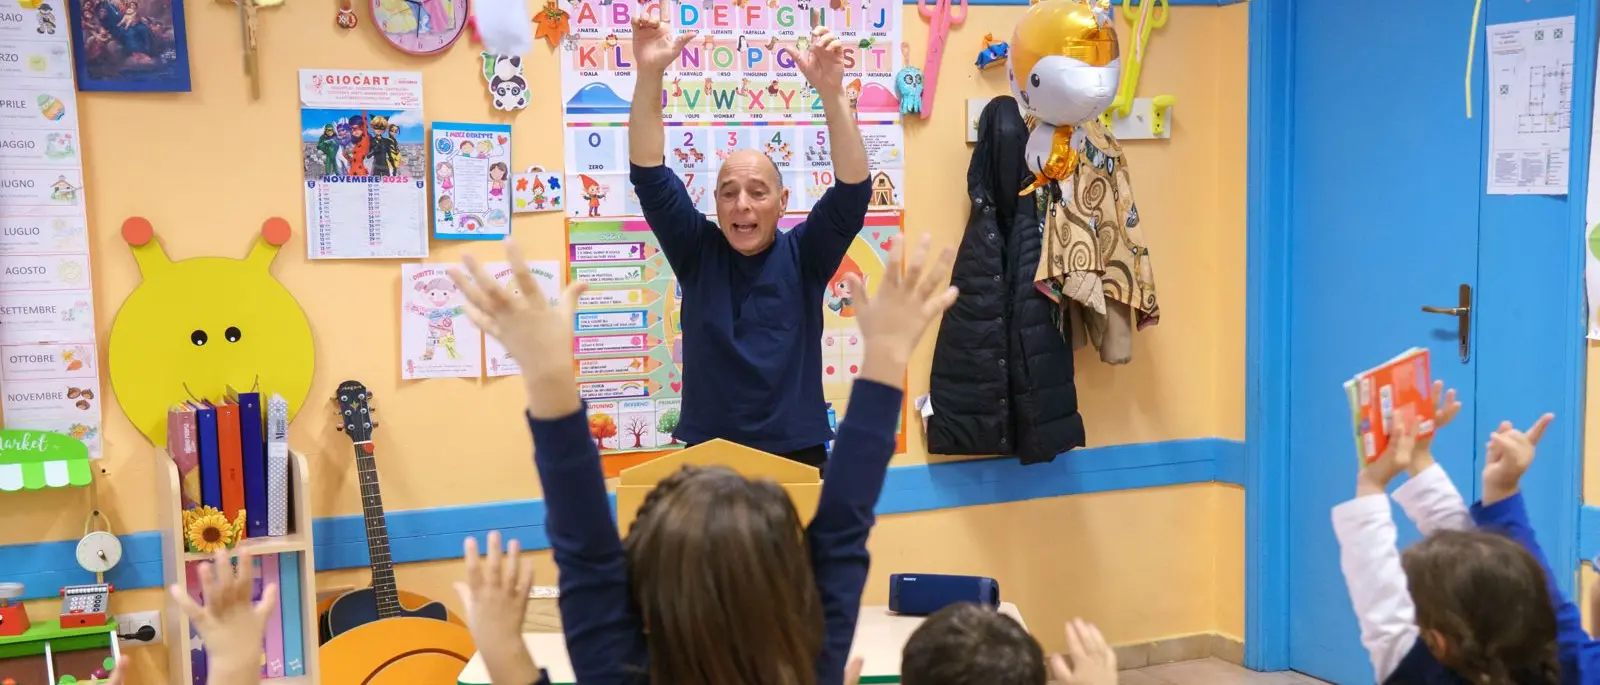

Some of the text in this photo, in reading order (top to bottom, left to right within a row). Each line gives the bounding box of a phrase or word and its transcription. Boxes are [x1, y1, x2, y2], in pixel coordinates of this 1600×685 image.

[577, 2, 597, 24] A
[613, 3, 630, 24] B
[681, 5, 698, 26] D
[714, 6, 728, 26] E
[746, 6, 761, 26] F
[776, 6, 794, 27] G
[846, 8, 850, 28] I
[874, 8, 886, 28] J
[580, 46, 885, 68] K L N O P Q S T
[326, 75, 390, 85] GIOCART
[683, 89, 700, 110] V
[713, 89, 735, 110] W
[748, 89, 764, 110] X
[779, 89, 795, 110] Y
[589, 131, 825, 148] 0 2 3 4 5
[685, 174, 694, 187] 7
[812, 171, 832, 185] 10
[4, 227, 40, 236] LUGLIO
[6, 266, 46, 275] AGOSTO
[0, 305, 56, 315] SETTEMBRE
[10, 354, 55, 364] OTTOBRE
[8, 391, 63, 401] NOVEMBRE
[0, 432, 48, 452] arket
